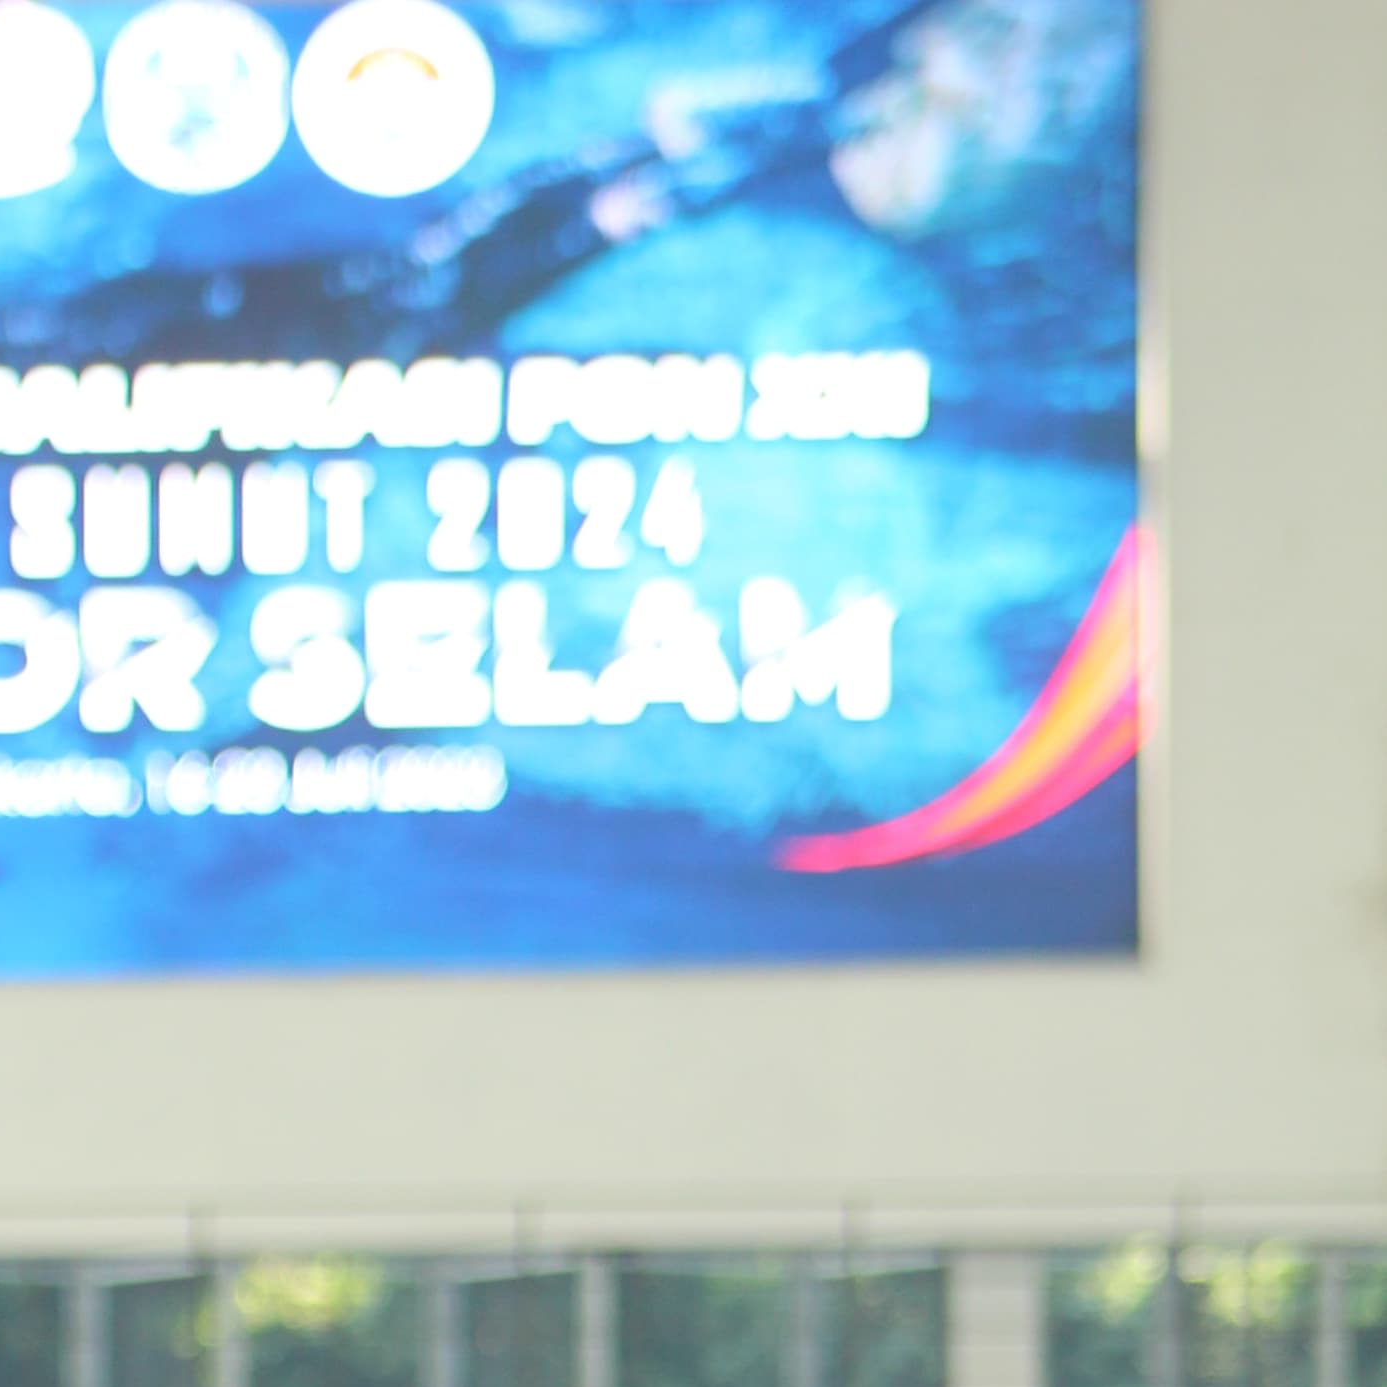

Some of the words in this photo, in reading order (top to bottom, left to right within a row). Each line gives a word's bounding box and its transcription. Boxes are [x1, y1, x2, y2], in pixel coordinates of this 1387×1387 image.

[10, 461, 376, 579] SUMUT
[426, 456, 706, 573] 2024
[246, 574, 899, 732] SELAM
